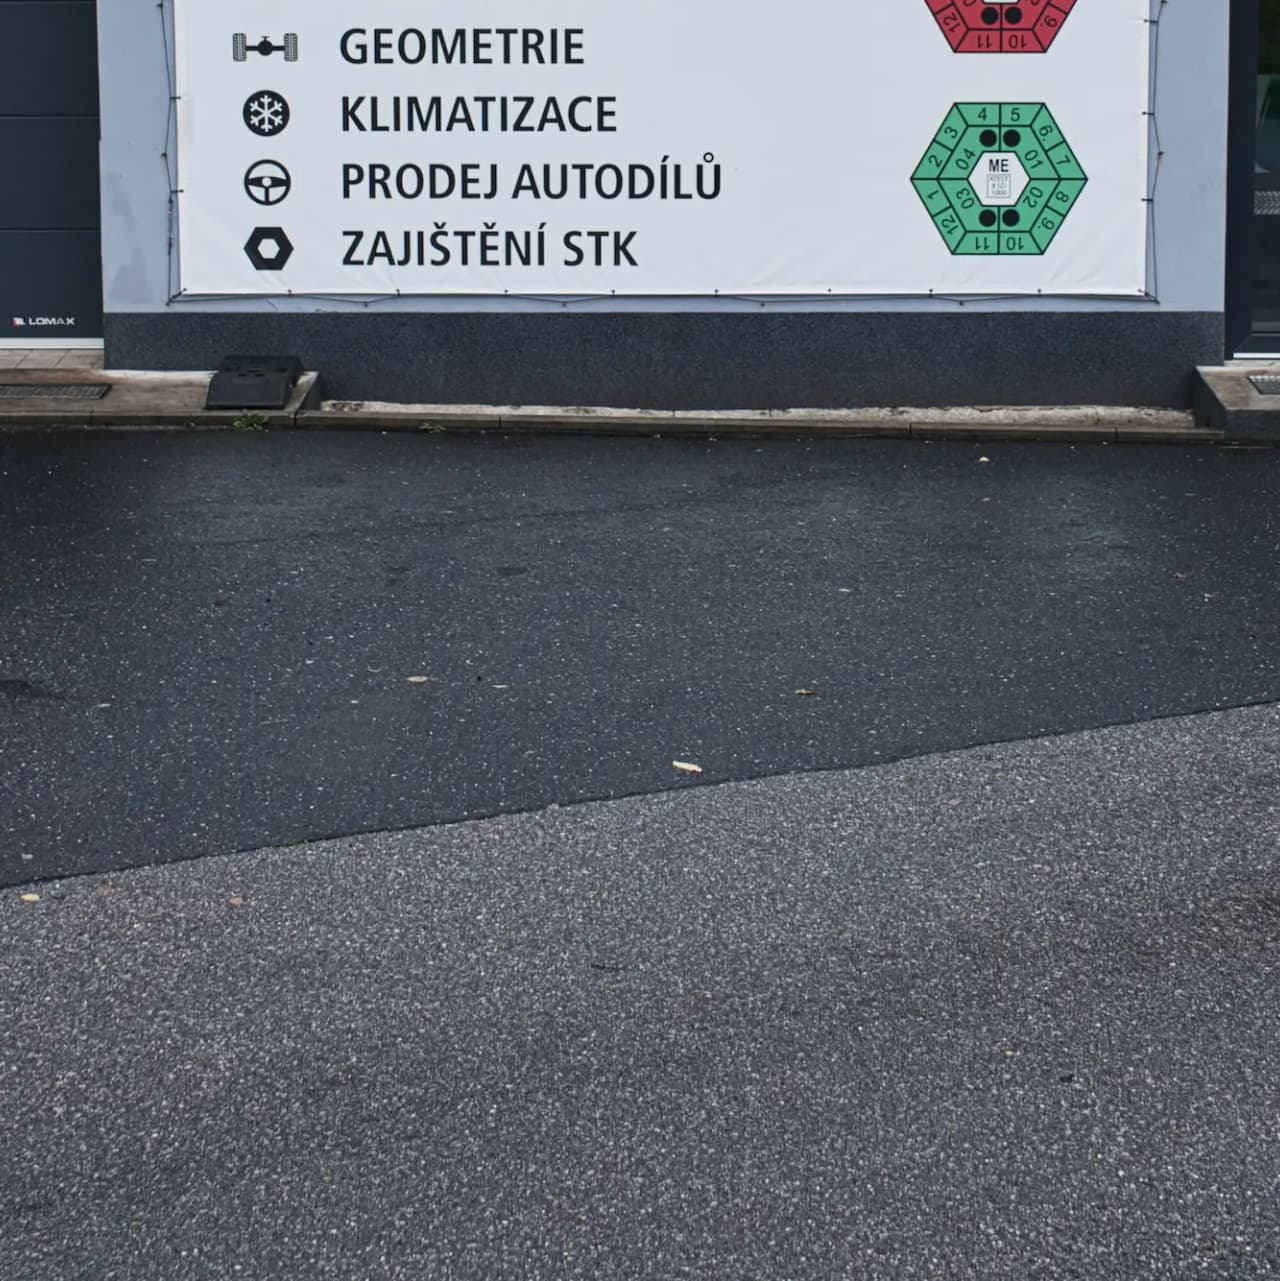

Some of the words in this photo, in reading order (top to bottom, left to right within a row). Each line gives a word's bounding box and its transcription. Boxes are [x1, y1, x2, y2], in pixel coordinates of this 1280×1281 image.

[944, 13, 961, 32] 12
[339, 28, 585, 65] GEOMETRIE
[977, 35, 991, 48] 11
[1009, 35, 1026, 48] 10
[342, 96, 617, 132] KLIMATIZACE
[978, 108, 987, 120] 4
[1011, 108, 1020, 121] 5
[945, 126, 958, 138] 3
[929, 155, 943, 167] 2
[956, 148, 976, 169] 04
[1025, 150, 1043, 169] 01
[1057, 156, 1070, 166] 7
[989, 160, 1008, 172] ME
[342, 163, 498, 200] PRODEJ
[511, 152, 722, 200] AUTODÍLŮ
[928, 190, 939, 200] 1
[956, 188, 974, 209] 03
[1023, 187, 1043, 208] 02
[1056, 192, 1069, 202] 8
[942, 215, 959, 235] 12
[342, 221, 547, 266] ZAJIŠTĚNÍ
[563, 230, 639, 267] STK
[975, 237, 989, 250] 11
[1006, 237, 1023, 250] 10
[28, 317, 75, 326] LOMAX
